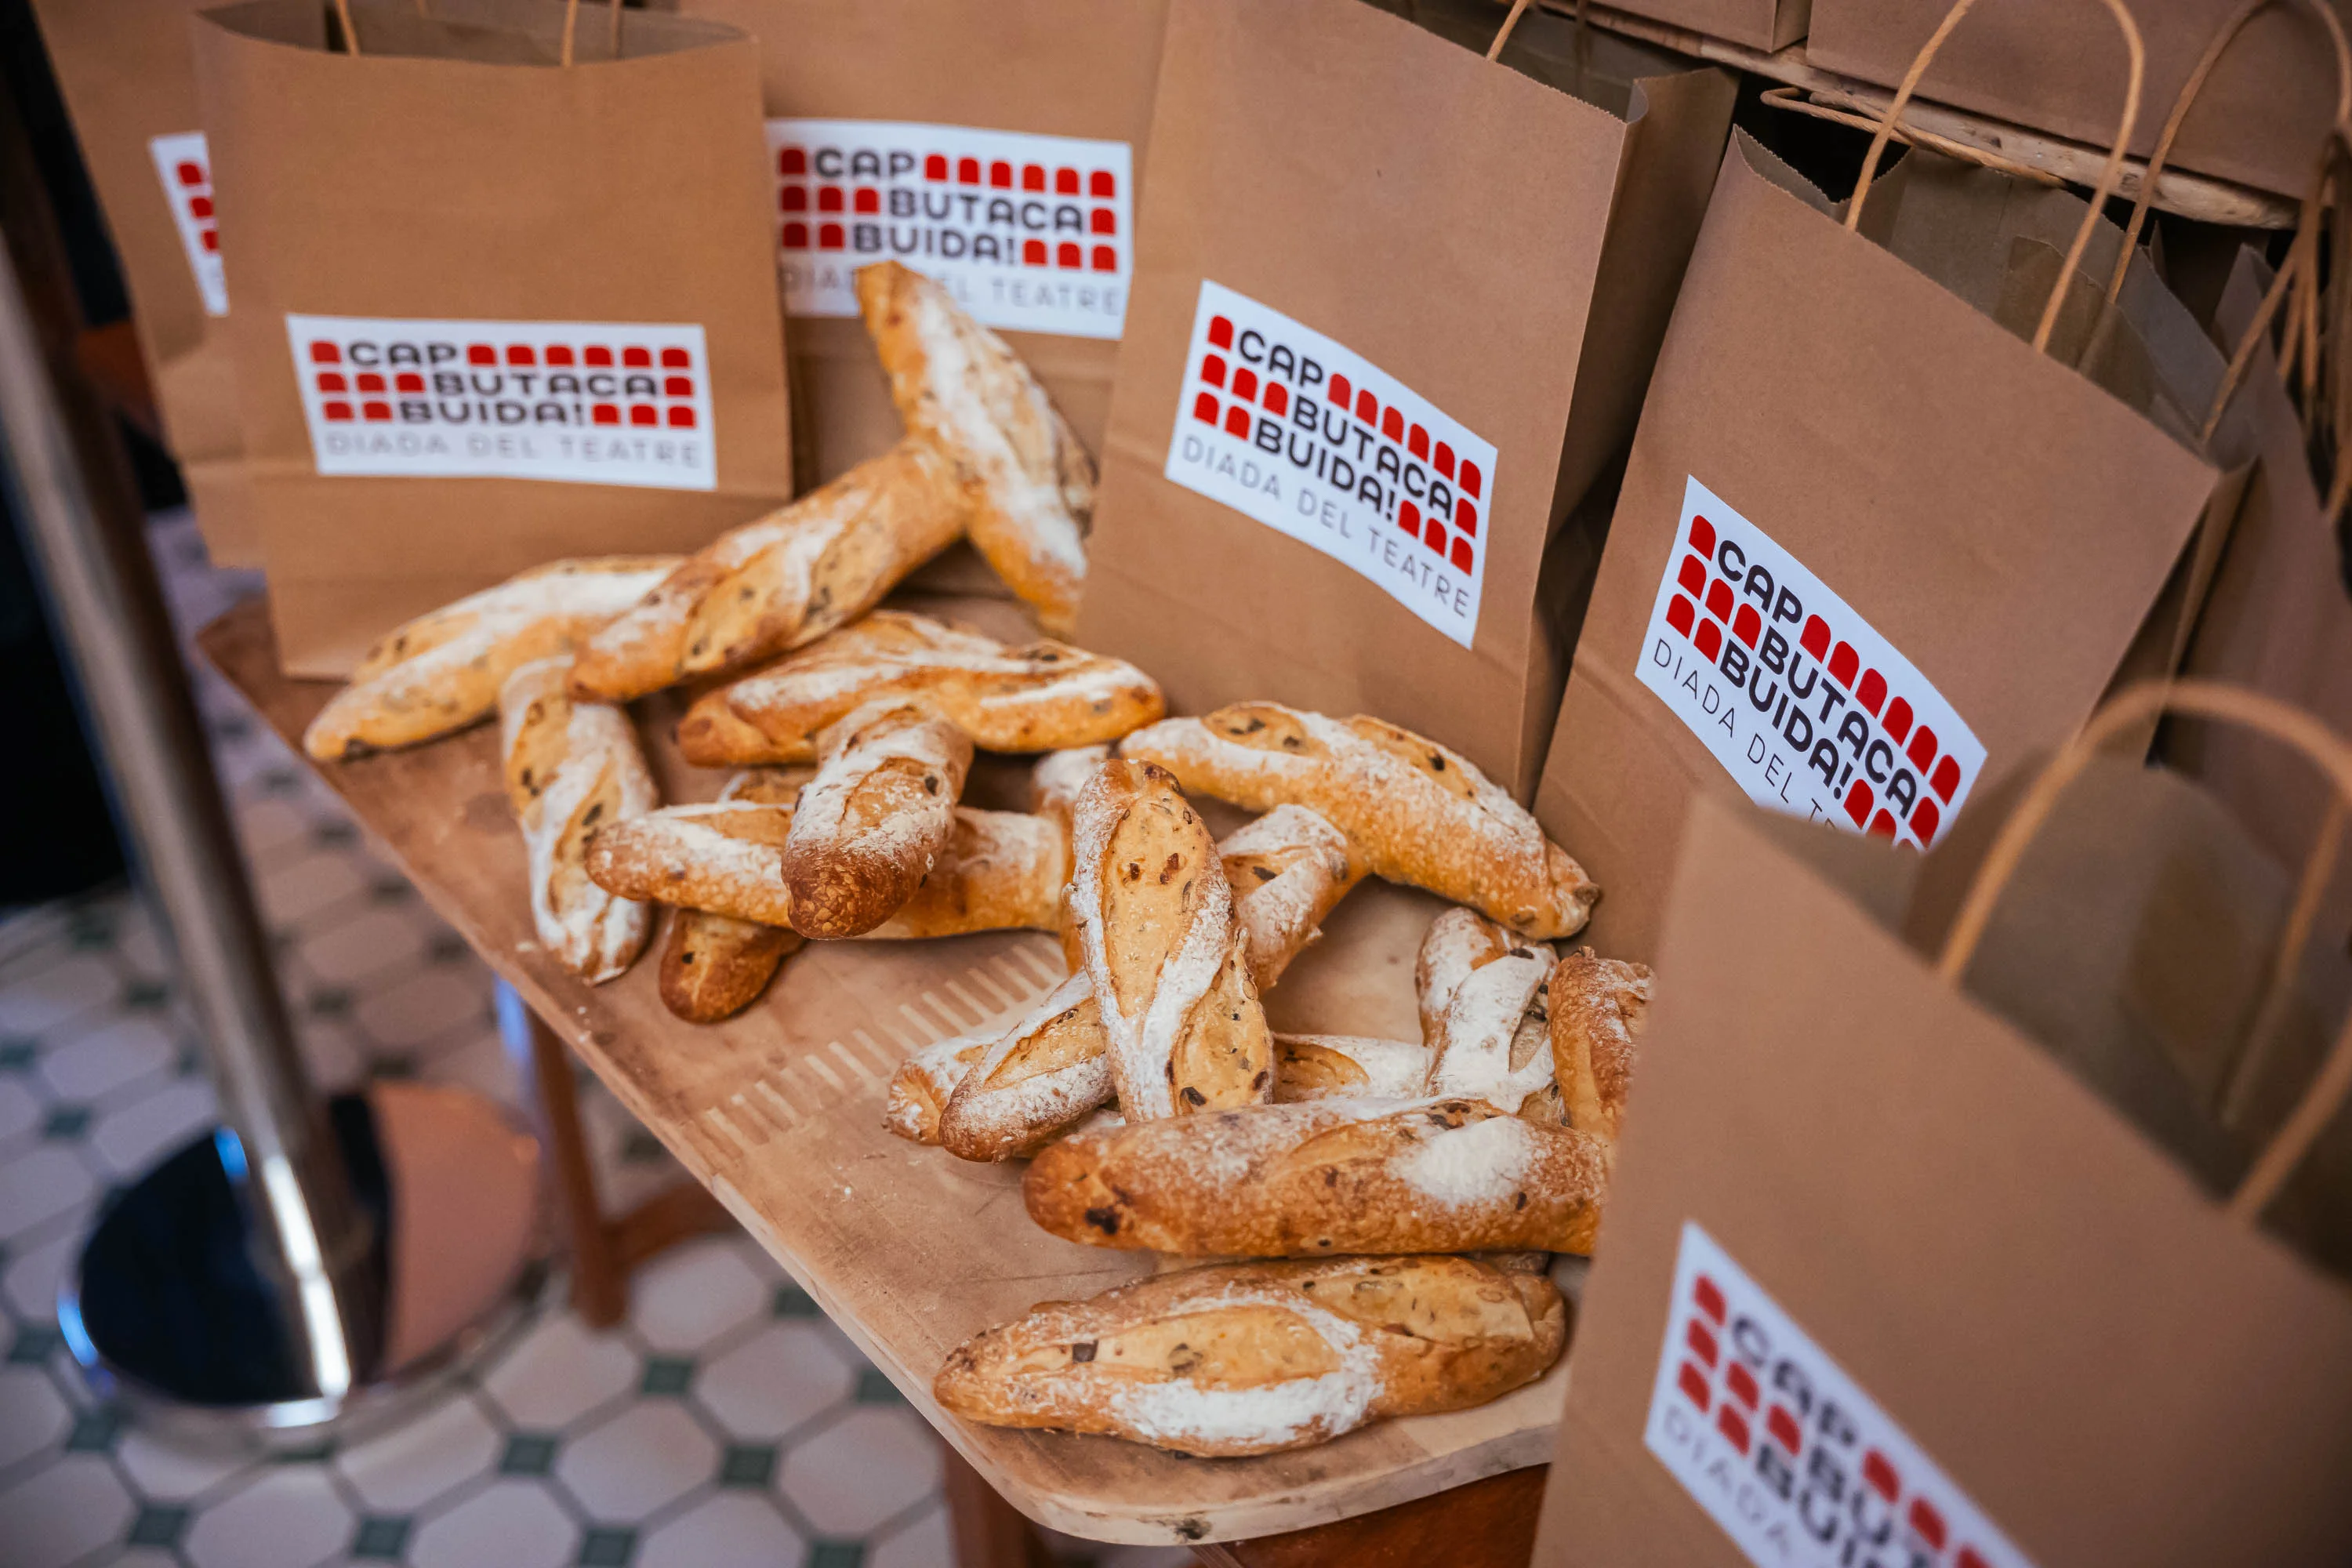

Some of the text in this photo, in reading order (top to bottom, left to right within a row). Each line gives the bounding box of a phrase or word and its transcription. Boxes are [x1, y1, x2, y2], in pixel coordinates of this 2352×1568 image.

[815, 148, 915, 179] CAP
[889, 188, 1083, 232] BUTACA
[854, 223, 1015, 264] BUIDA!
[349, 341, 458, 366] CAP
[1239, 330, 1323, 388] CAP
[400, 400, 584, 426] BUIDA!
[433, 372, 658, 396] BUTACA
[325, 432, 702, 469] DIADA DEL TEATRE
[1255, 418, 1396, 521] BUIDA!
[1293, 394, 1452, 521] BUTACA
[1182, 434, 1470, 618] DIADA DEL TEATRE
[1718, 539, 1803, 624] CAP
[1653, 638, 1794, 804] DIADA DEL
[1719, 638, 1854, 800] BUIDA!
[1759, 625, 1918, 819] BUTACA
